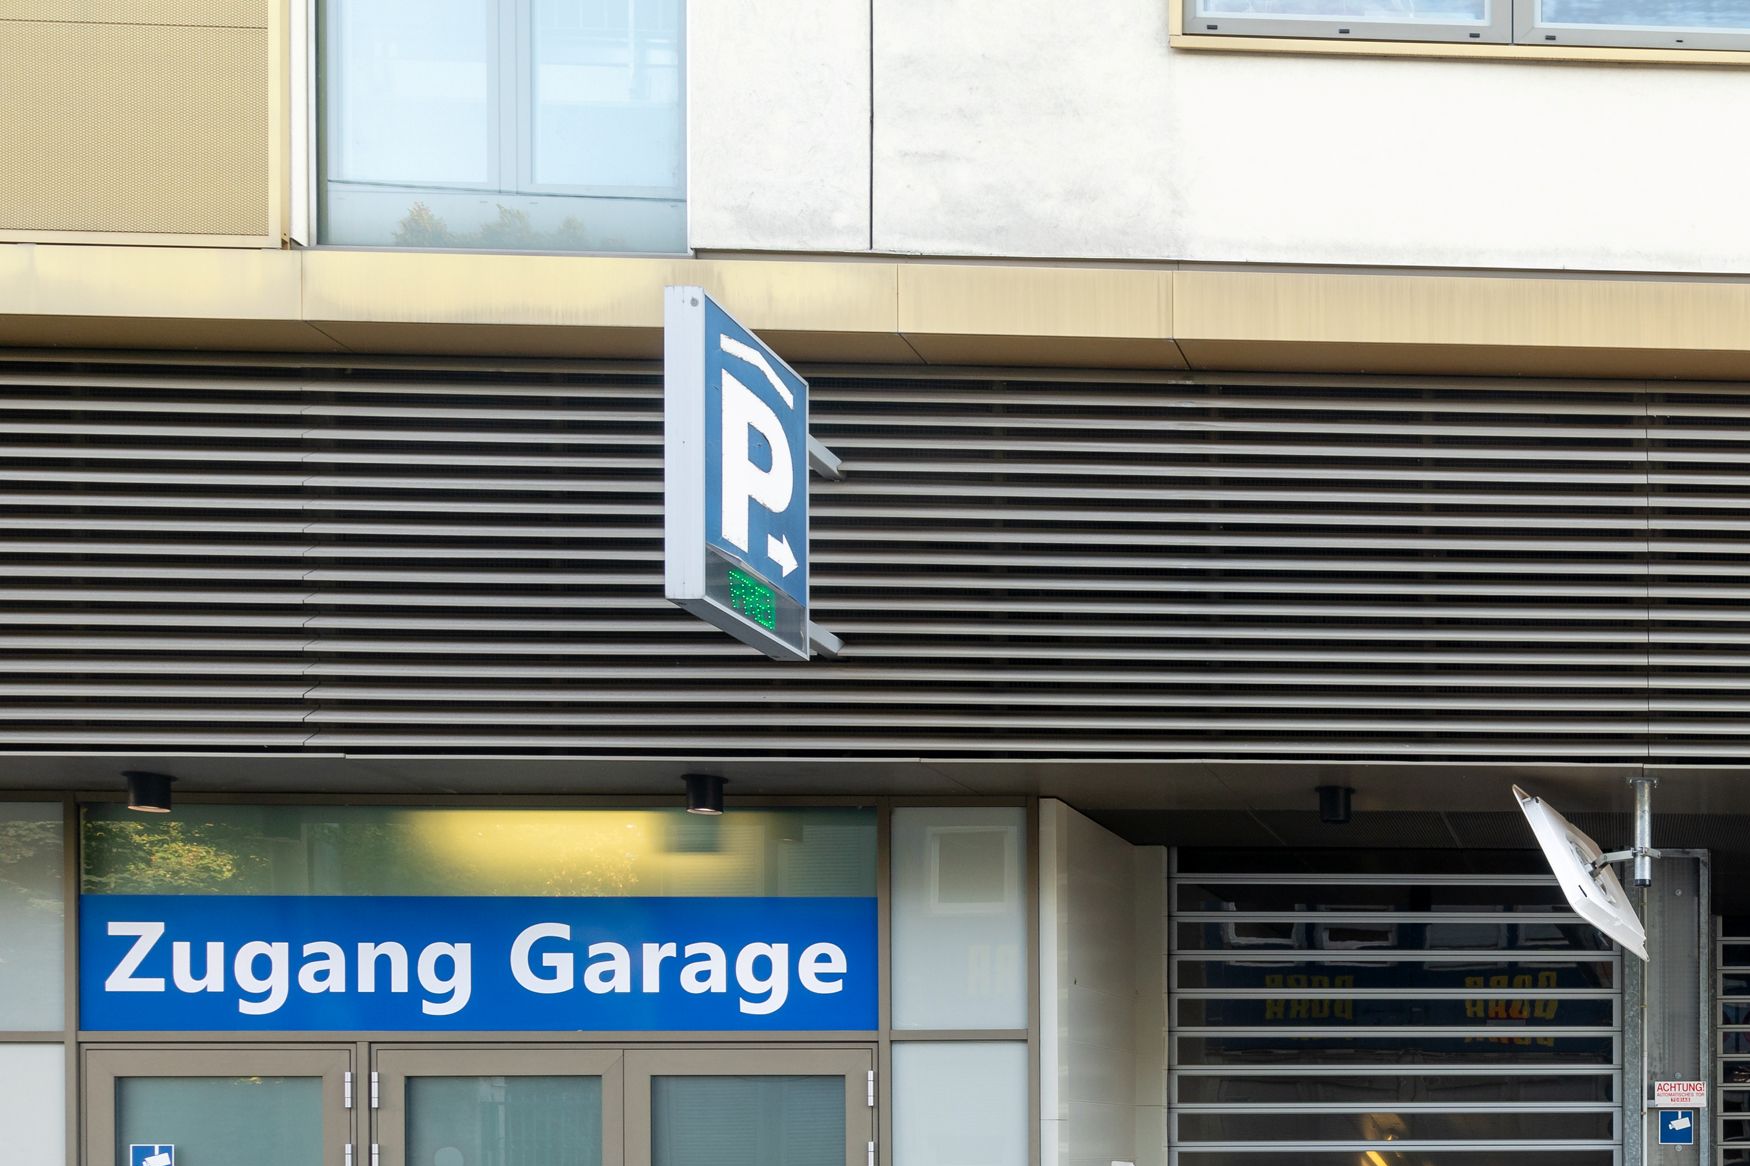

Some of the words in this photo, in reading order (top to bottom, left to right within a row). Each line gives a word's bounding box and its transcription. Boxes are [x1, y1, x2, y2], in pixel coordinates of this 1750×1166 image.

[722, 368, 794, 553] P
[728, 571, 774, 629] FREI
[105, 921, 472, 1016] Zugang
[510, 922, 847, 1015] Garage
[1656, 1082, 1705, 1092] ACHTUNG!
